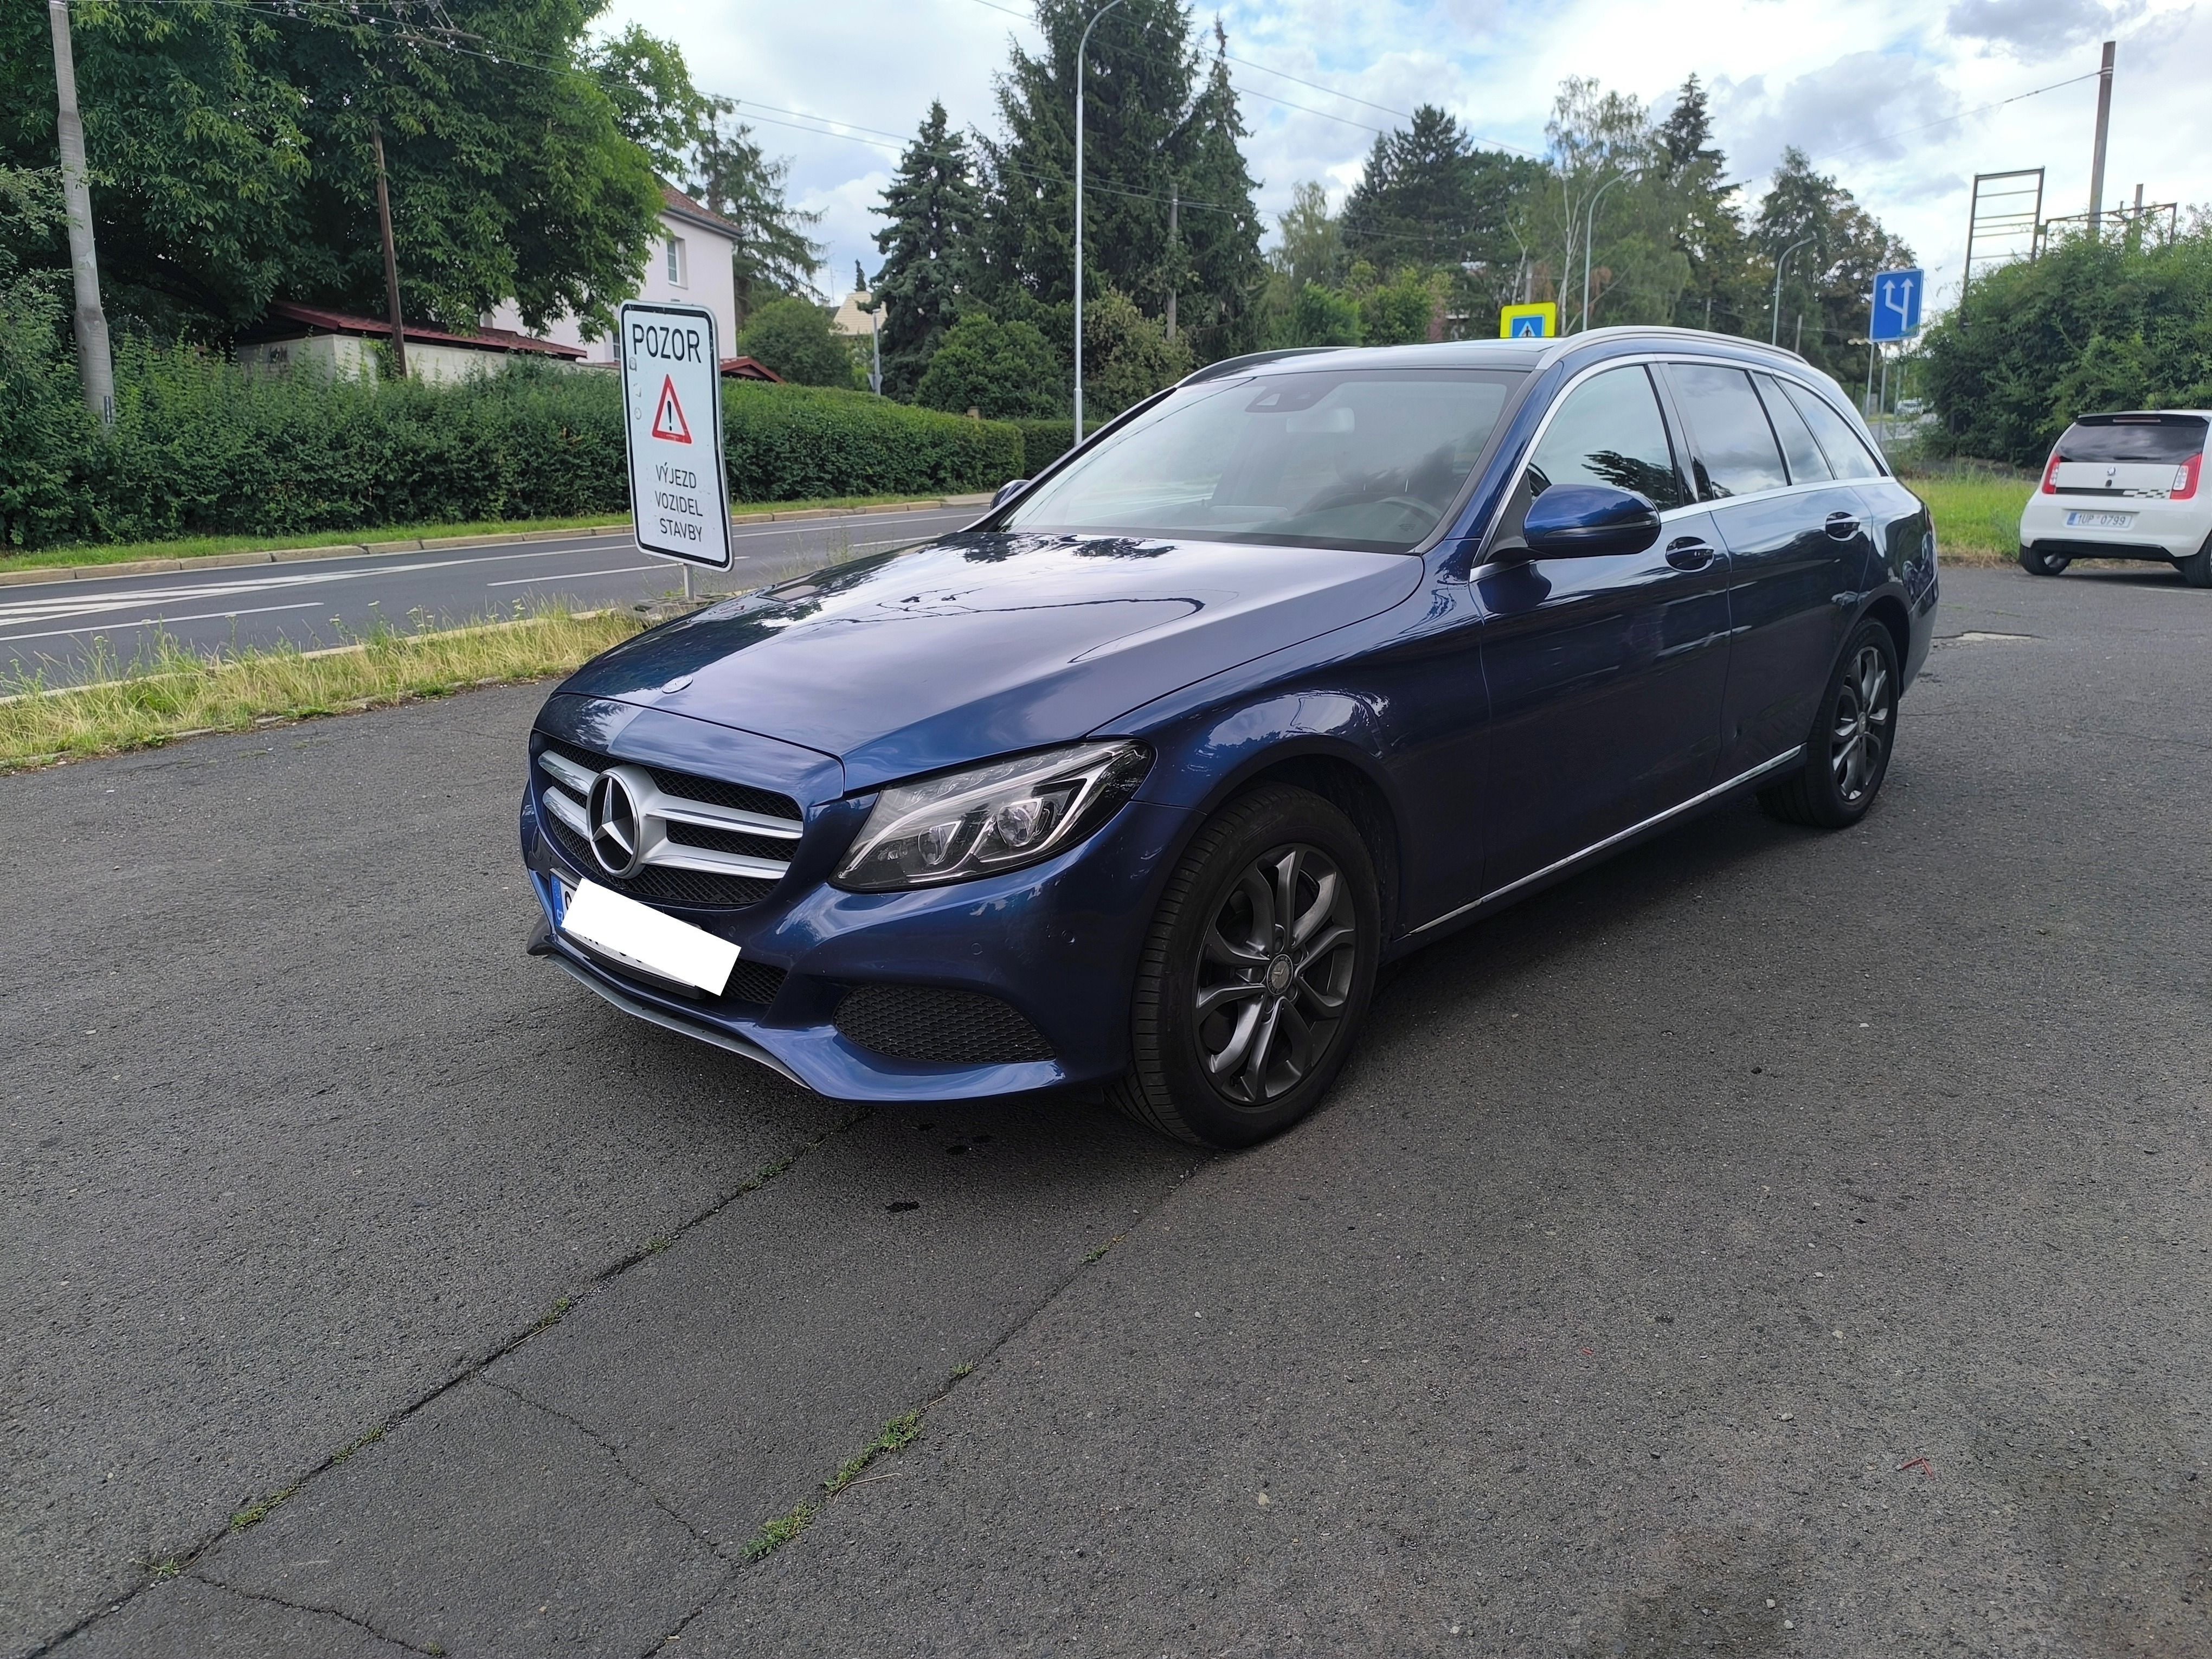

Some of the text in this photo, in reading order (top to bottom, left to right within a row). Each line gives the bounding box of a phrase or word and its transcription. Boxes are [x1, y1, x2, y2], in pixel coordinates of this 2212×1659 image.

[632, 324, 701, 363] POZOR
[655, 462, 696, 488] VÝJEZD
[654, 490, 703, 517] VOZIDEL
[659, 518, 702, 542] STAVBY
[2078, 514, 2126, 526] 1UP 0799
